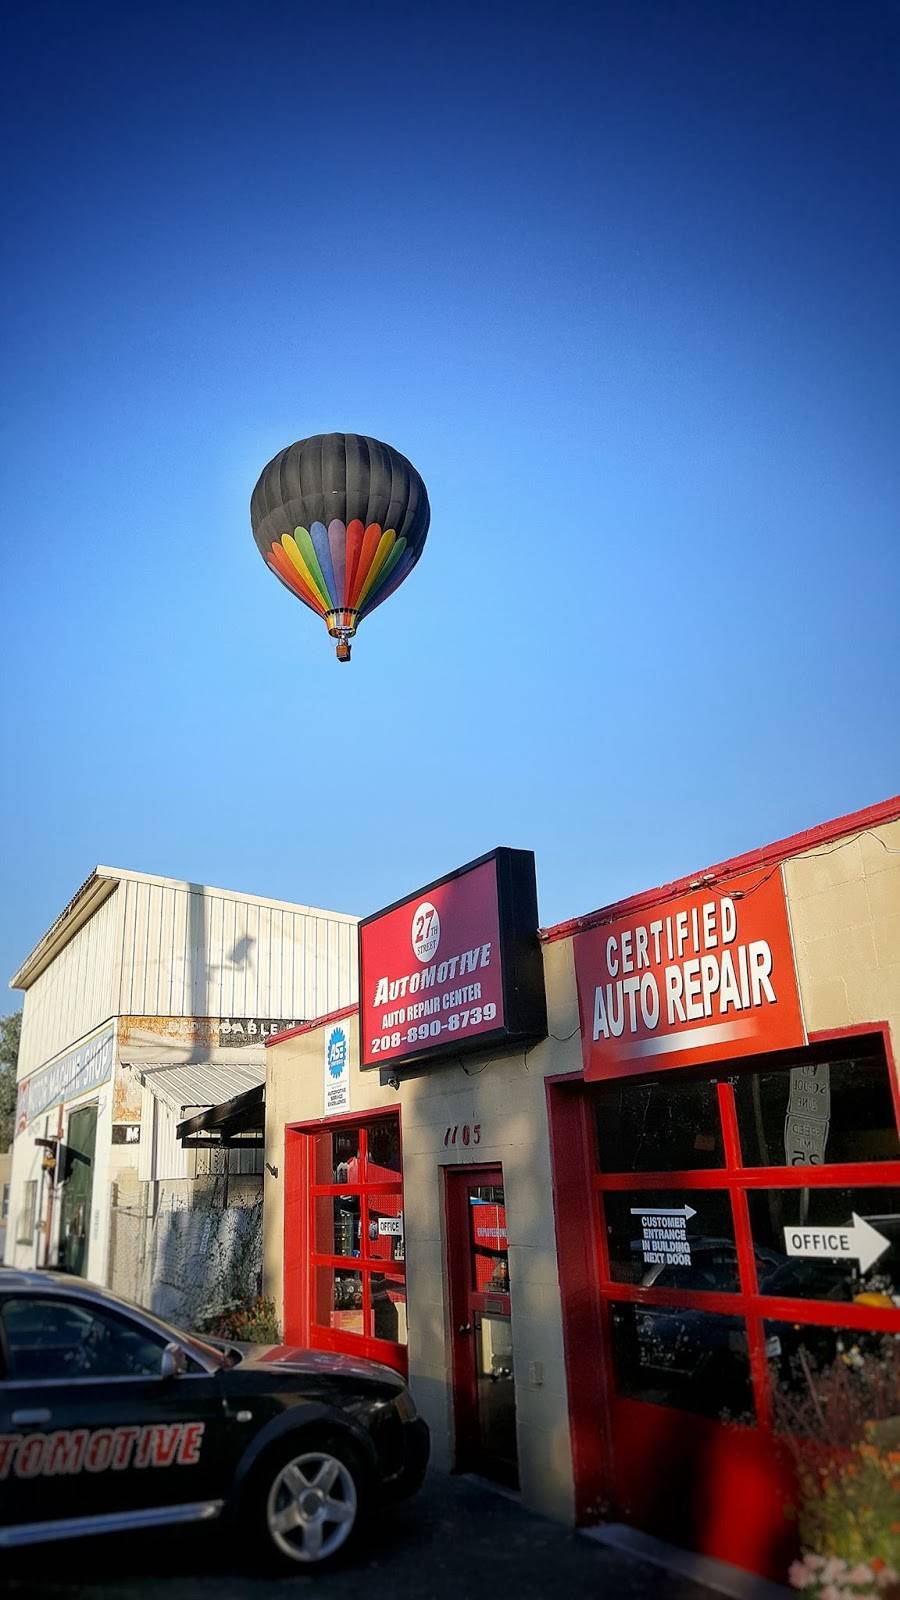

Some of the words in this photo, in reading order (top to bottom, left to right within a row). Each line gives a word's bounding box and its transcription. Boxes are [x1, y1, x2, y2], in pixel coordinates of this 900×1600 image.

[606, 897, 738, 977] CERTIFIED
[417, 943, 437, 956] STREET
[592, 972, 660, 1041] AUTO
[664, 939, 777, 1025] REPAIR
[382, 1010, 406, 1030] AUTO
[407, 997, 441, 1022] REPAIR
[442, 982, 482, 1009] CENTER
[371, 1002, 497, 1054] 208-890-8739
[330, 1040, 344, 1063] ASE
[380, 1220, 400, 1233] OFFICE
[641, 1216, 687, 1229] CUSTOMER
[643, 1228, 687, 1241] ENTRANCE
[791, 1233, 850, 1251] OFFICE
[641, 1240, 651, 1251] IN
[652, 1240, 691, 1254] BUILDING
[643, 1251, 666, 1264] NEXT
[666, 1253, 692, 1267] DOOR
